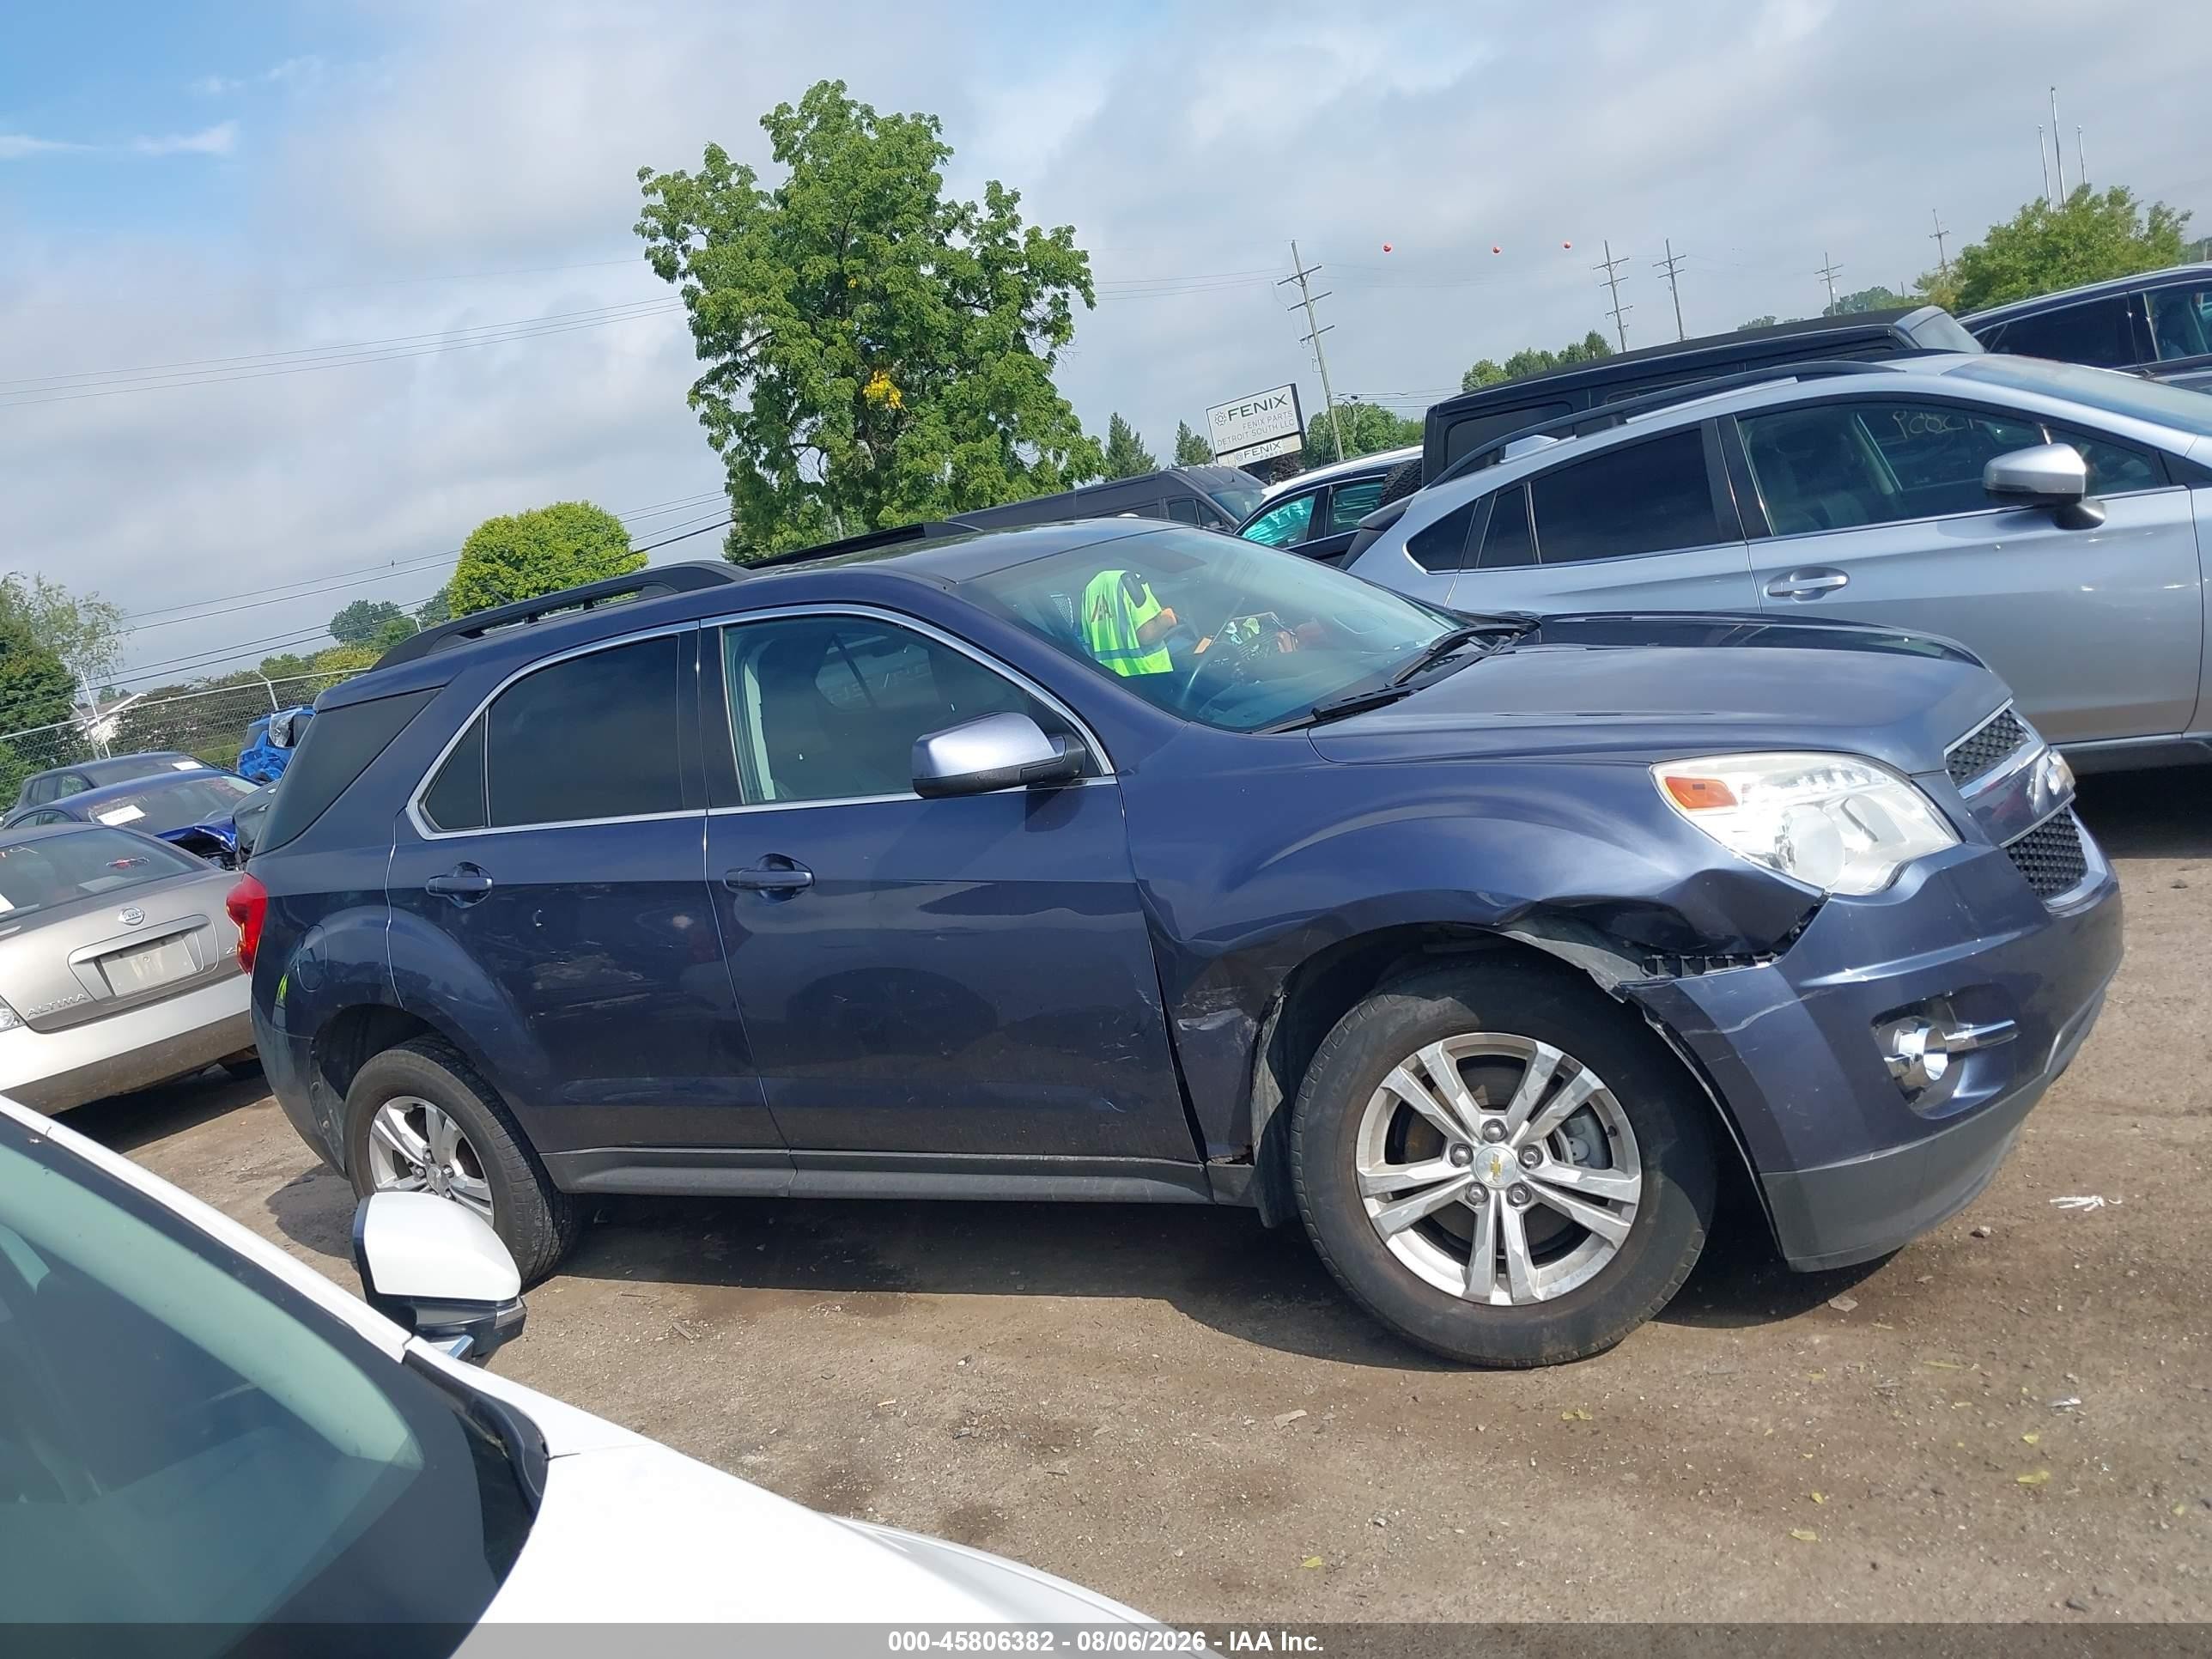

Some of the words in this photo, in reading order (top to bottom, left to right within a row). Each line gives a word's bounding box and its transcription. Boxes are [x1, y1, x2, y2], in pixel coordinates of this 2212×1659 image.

[1228, 393, 1288, 422] FENIX
[1243, 417, 1267, 430] FENIX
[1267, 410, 1293, 424] PARTS
[1217, 431, 1249, 447] DETROIT
[1251, 424, 1279, 437] SOUTH
[1279, 418, 1295, 429] LLC
[1243, 441, 1282, 459] FENIX
[27, 993, 88, 1018] ALTIMA
